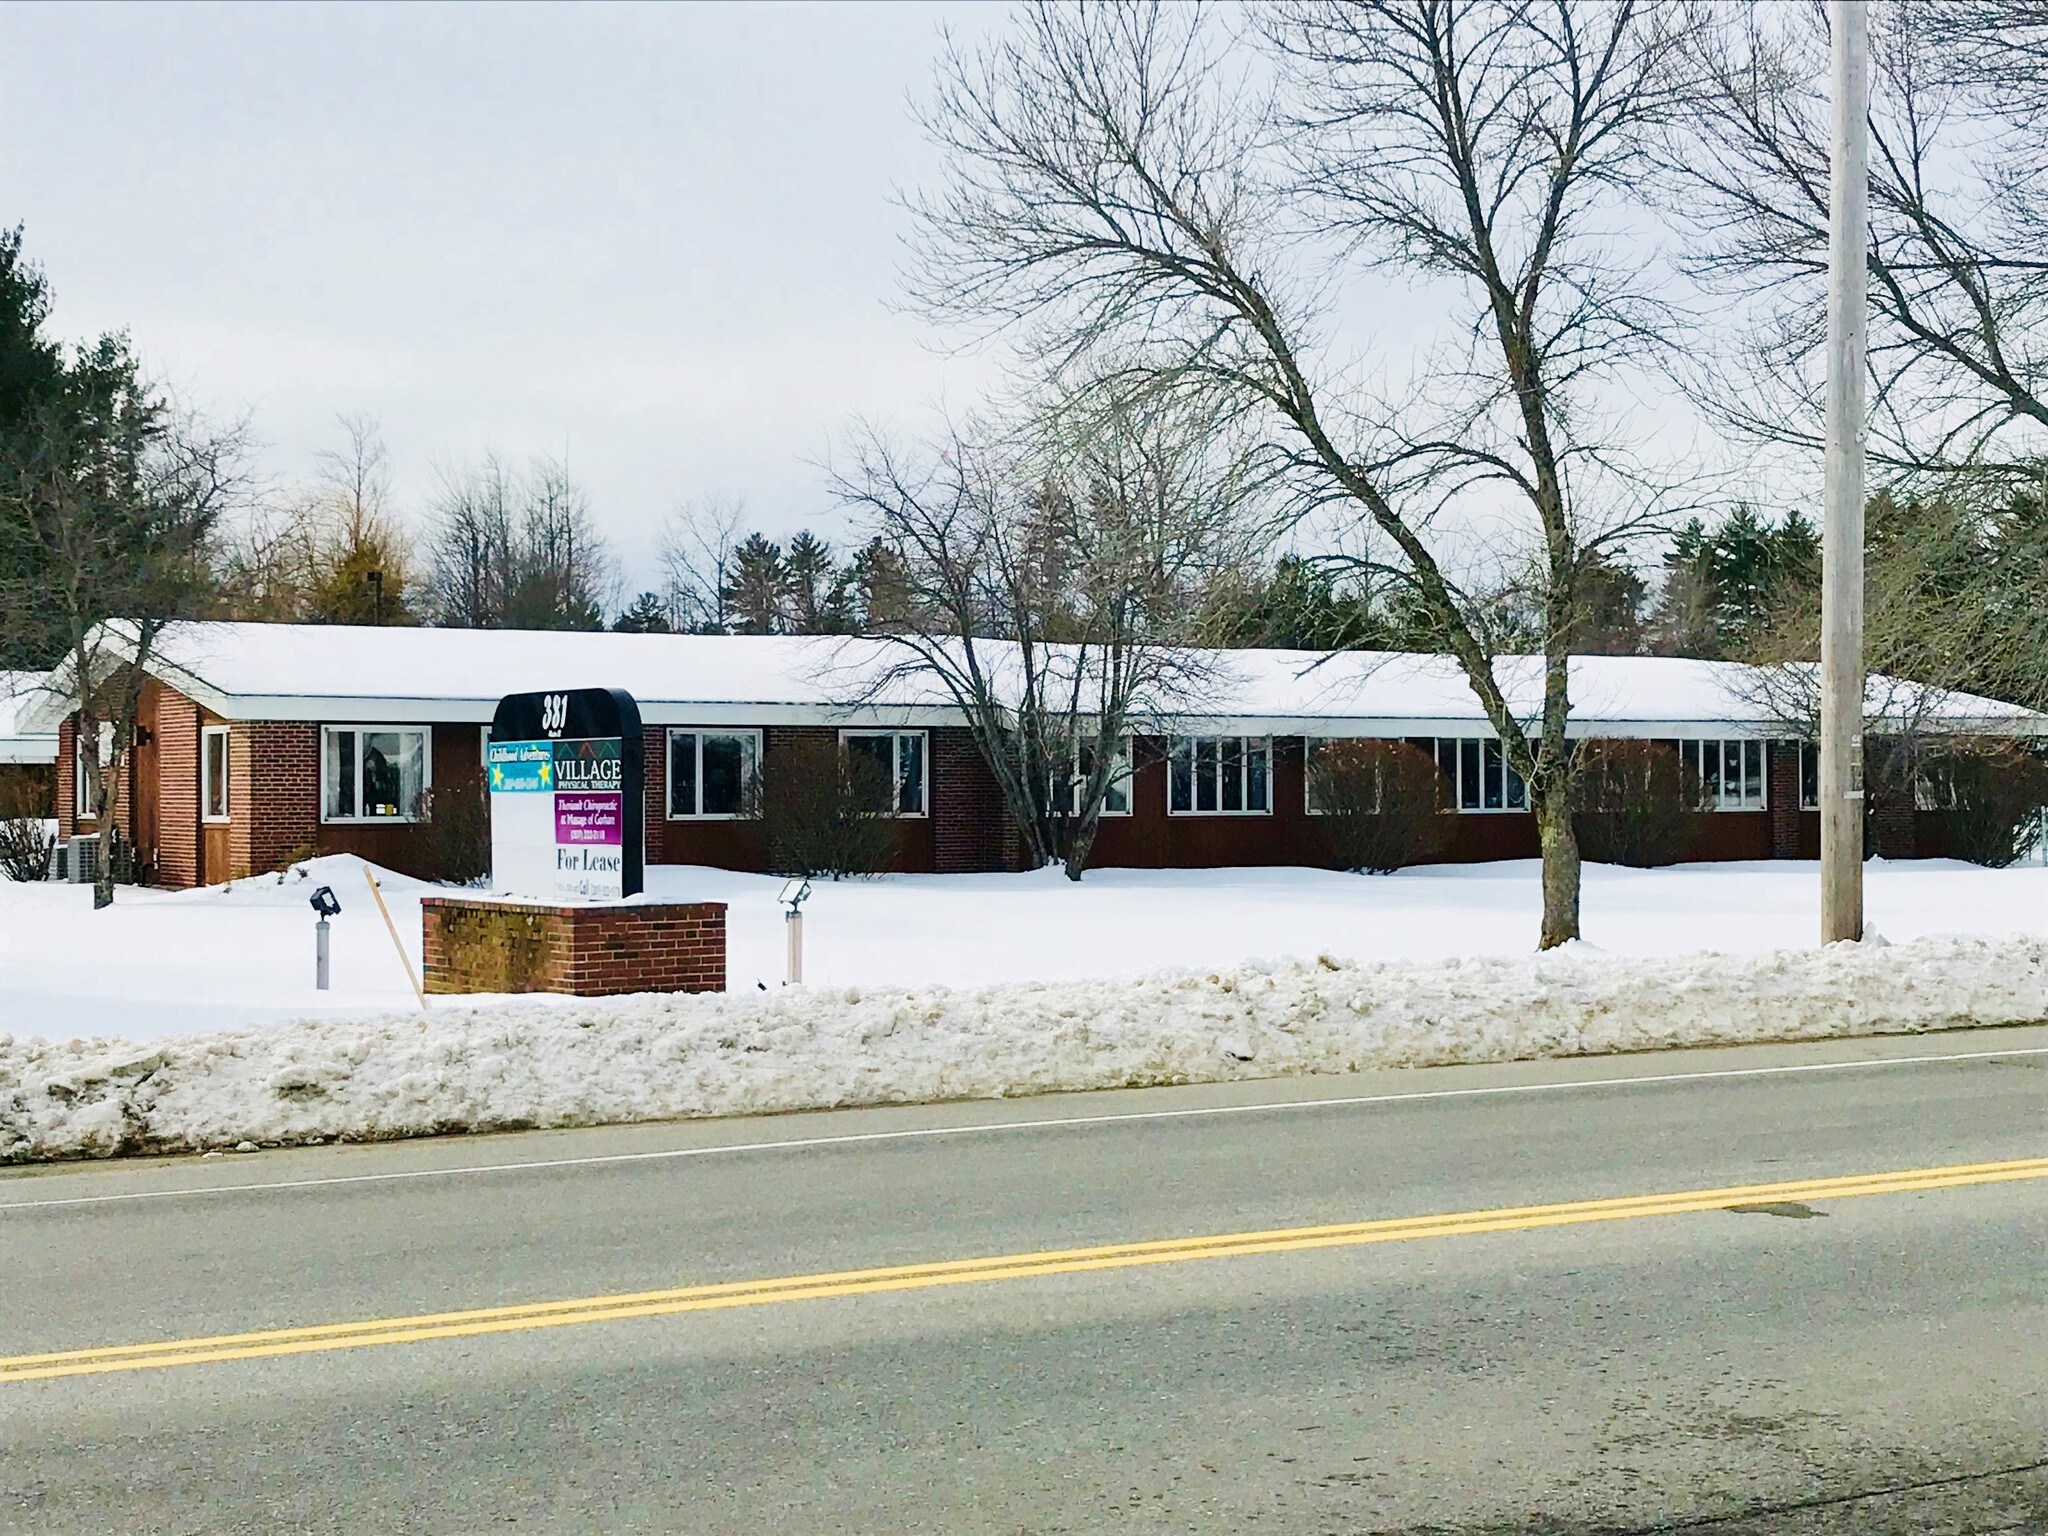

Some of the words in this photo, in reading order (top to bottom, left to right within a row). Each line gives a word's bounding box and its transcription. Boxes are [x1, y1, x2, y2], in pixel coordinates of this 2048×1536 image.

[542, 694, 568, 730] 381
[554, 759, 622, 780] VILLAGE
[558, 780, 589, 789] PHYSICAL
[591, 780, 621, 789] THERAPY
[587, 813, 594, 825] of
[557, 848, 579, 870] For
[583, 848, 620, 871] Lease
